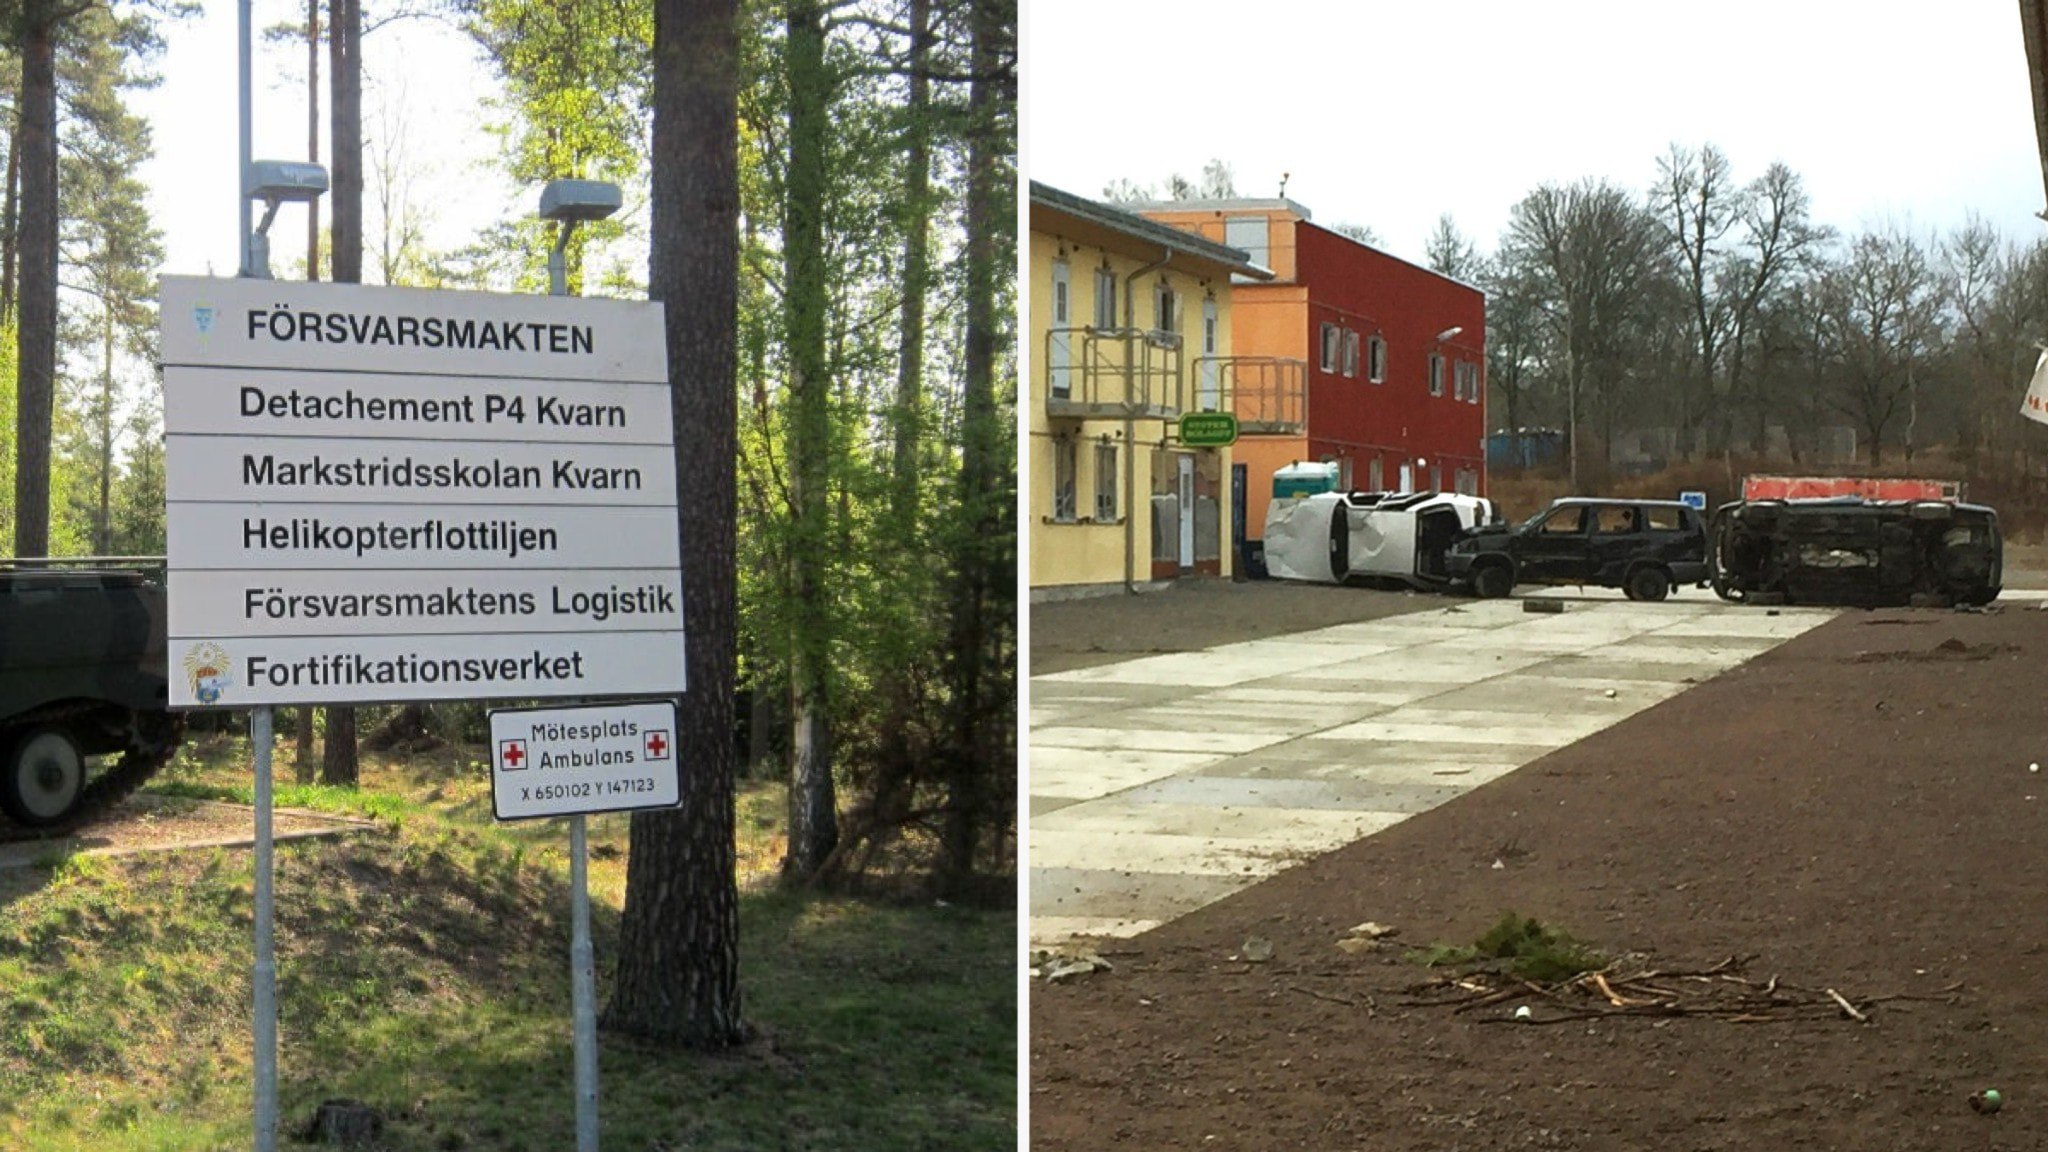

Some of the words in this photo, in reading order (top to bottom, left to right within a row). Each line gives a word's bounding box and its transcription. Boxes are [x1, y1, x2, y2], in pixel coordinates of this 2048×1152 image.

[248, 304, 594, 354] FÖRSVARSMAKTEN
[240, 387, 474, 424] Detachement
[485, 393, 527, 425] P4
[538, 396, 626, 428] Kvarn
[244, 455, 541, 490] Markstridsskolan
[553, 460, 642, 491] Kvarn
[244, 518, 558, 559] Helikopterflottiljen
[246, 586, 536, 619] Försvarsmaktens
[553, 584, 675, 621] Logistik
[247, 650, 585, 688] Fortifikationsverket
[531, 720, 638, 743] Mötesplats
[540, 749, 635, 769] Ambulans
[521, 786, 530, 801] X
[535, 782, 591, 800] 650102
[595, 781, 604, 796] Y
[607, 778, 656, 795] 147123
